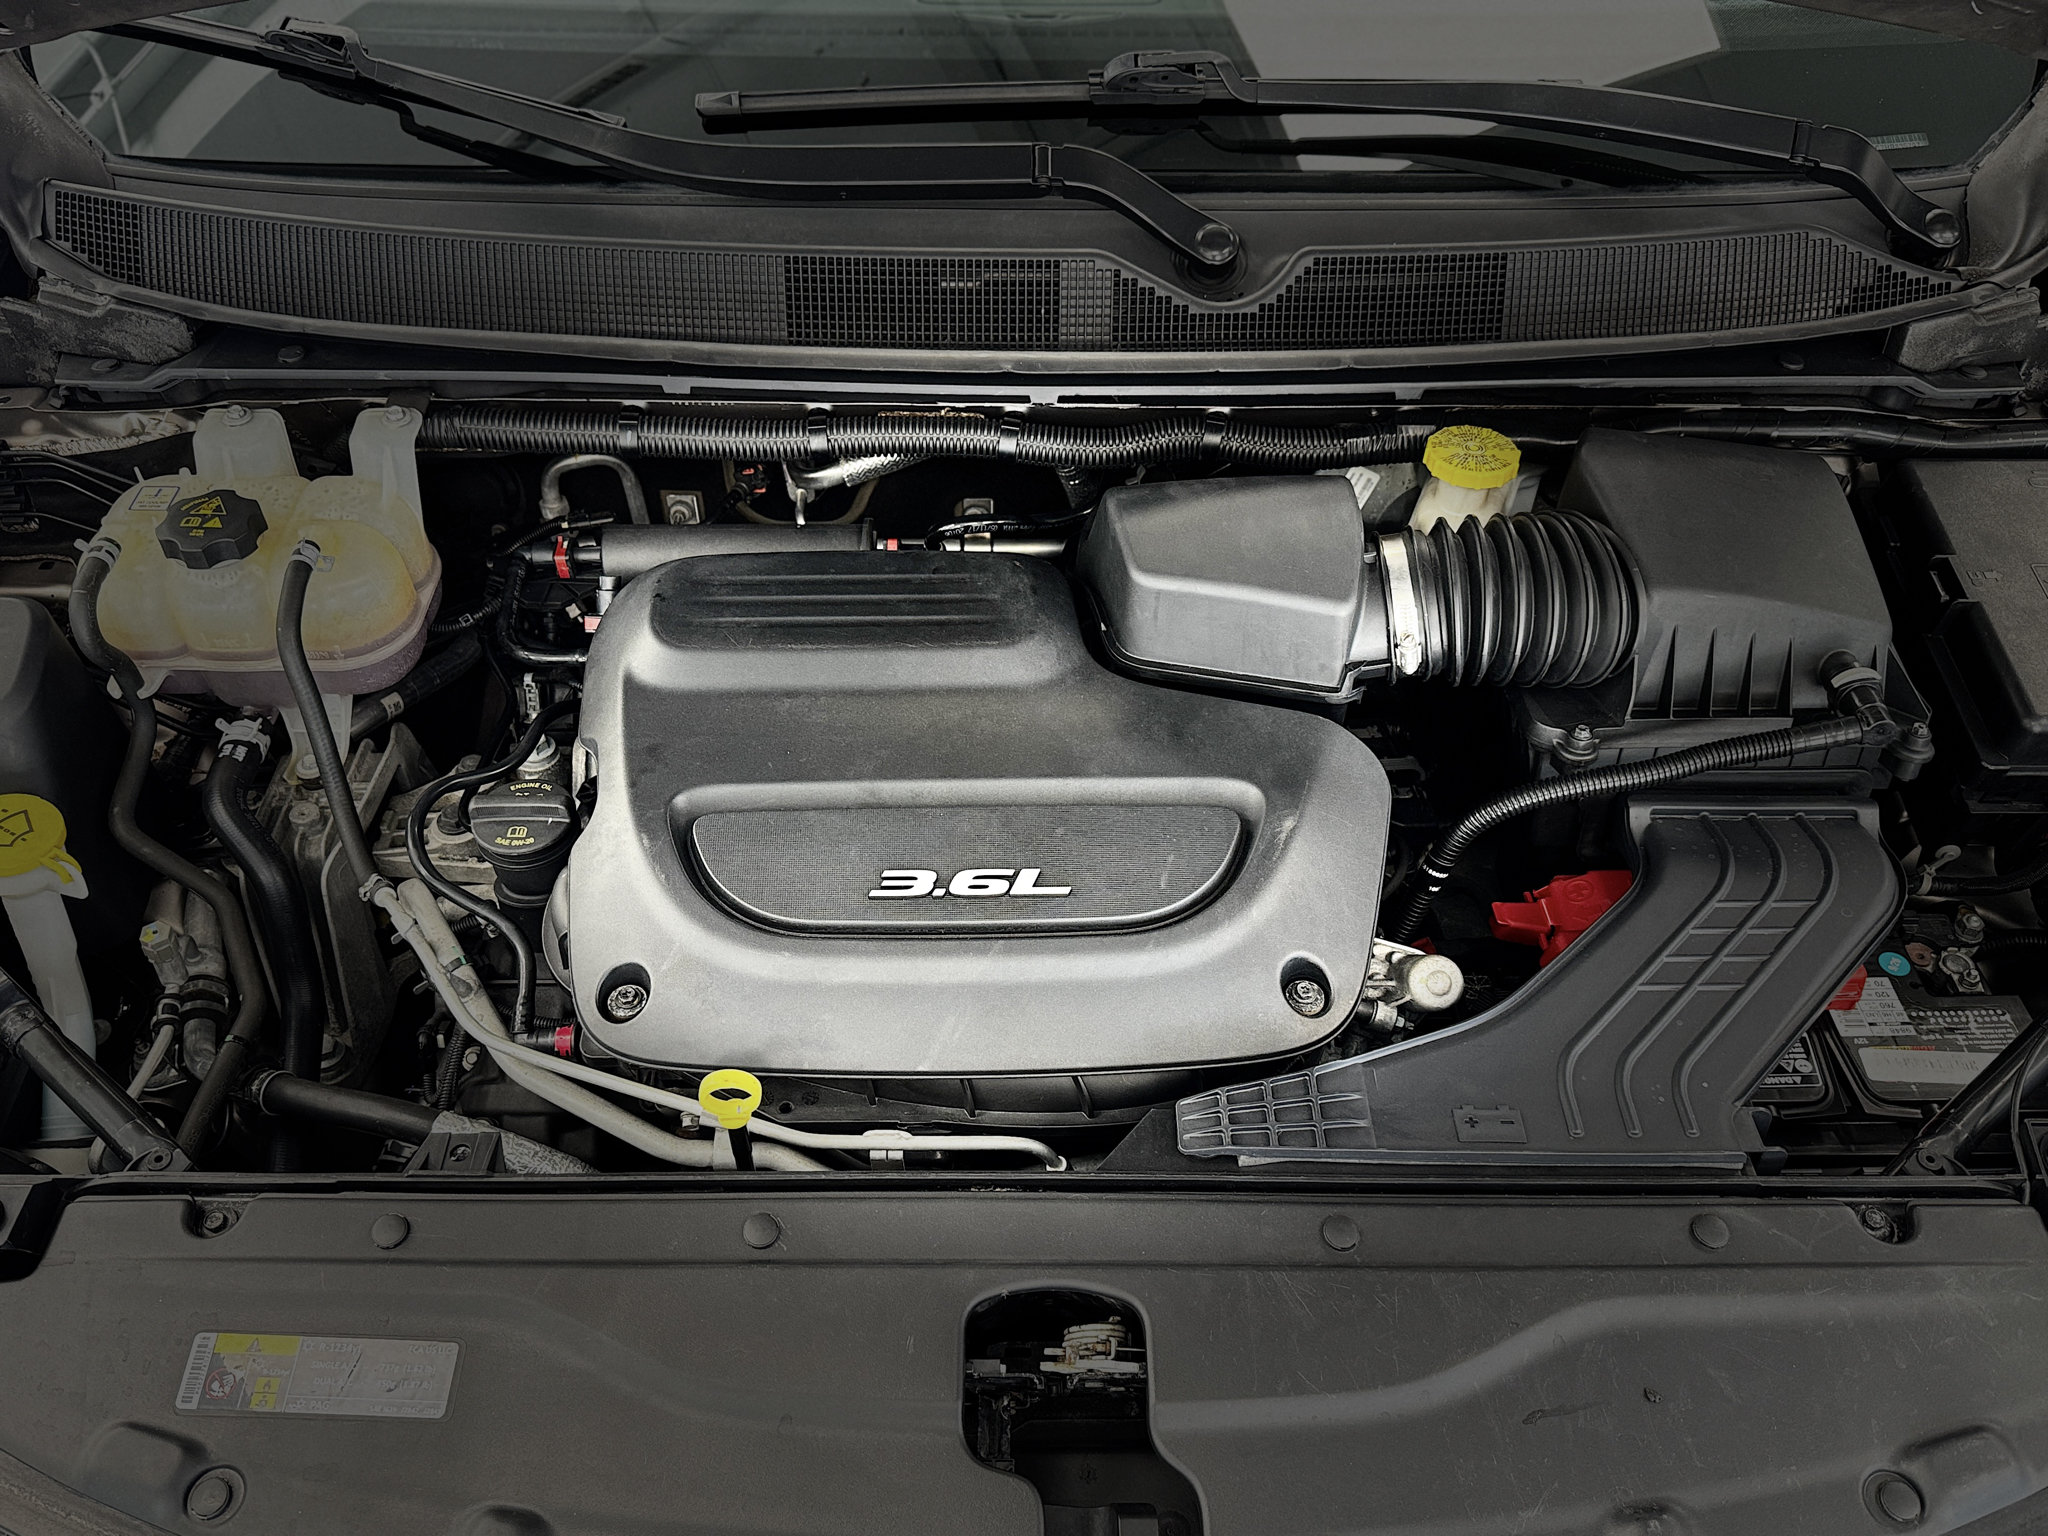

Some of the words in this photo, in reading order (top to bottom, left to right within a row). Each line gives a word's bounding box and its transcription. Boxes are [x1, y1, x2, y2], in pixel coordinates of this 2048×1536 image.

[509, 781, 541, 791] ENGINE
[541, 782, 553, 791] OIL
[494, 836, 511, 846] SAE
[868, 868, 1072, 900] 3.6L
[1853, 1037, 1869, 1045] 12V
